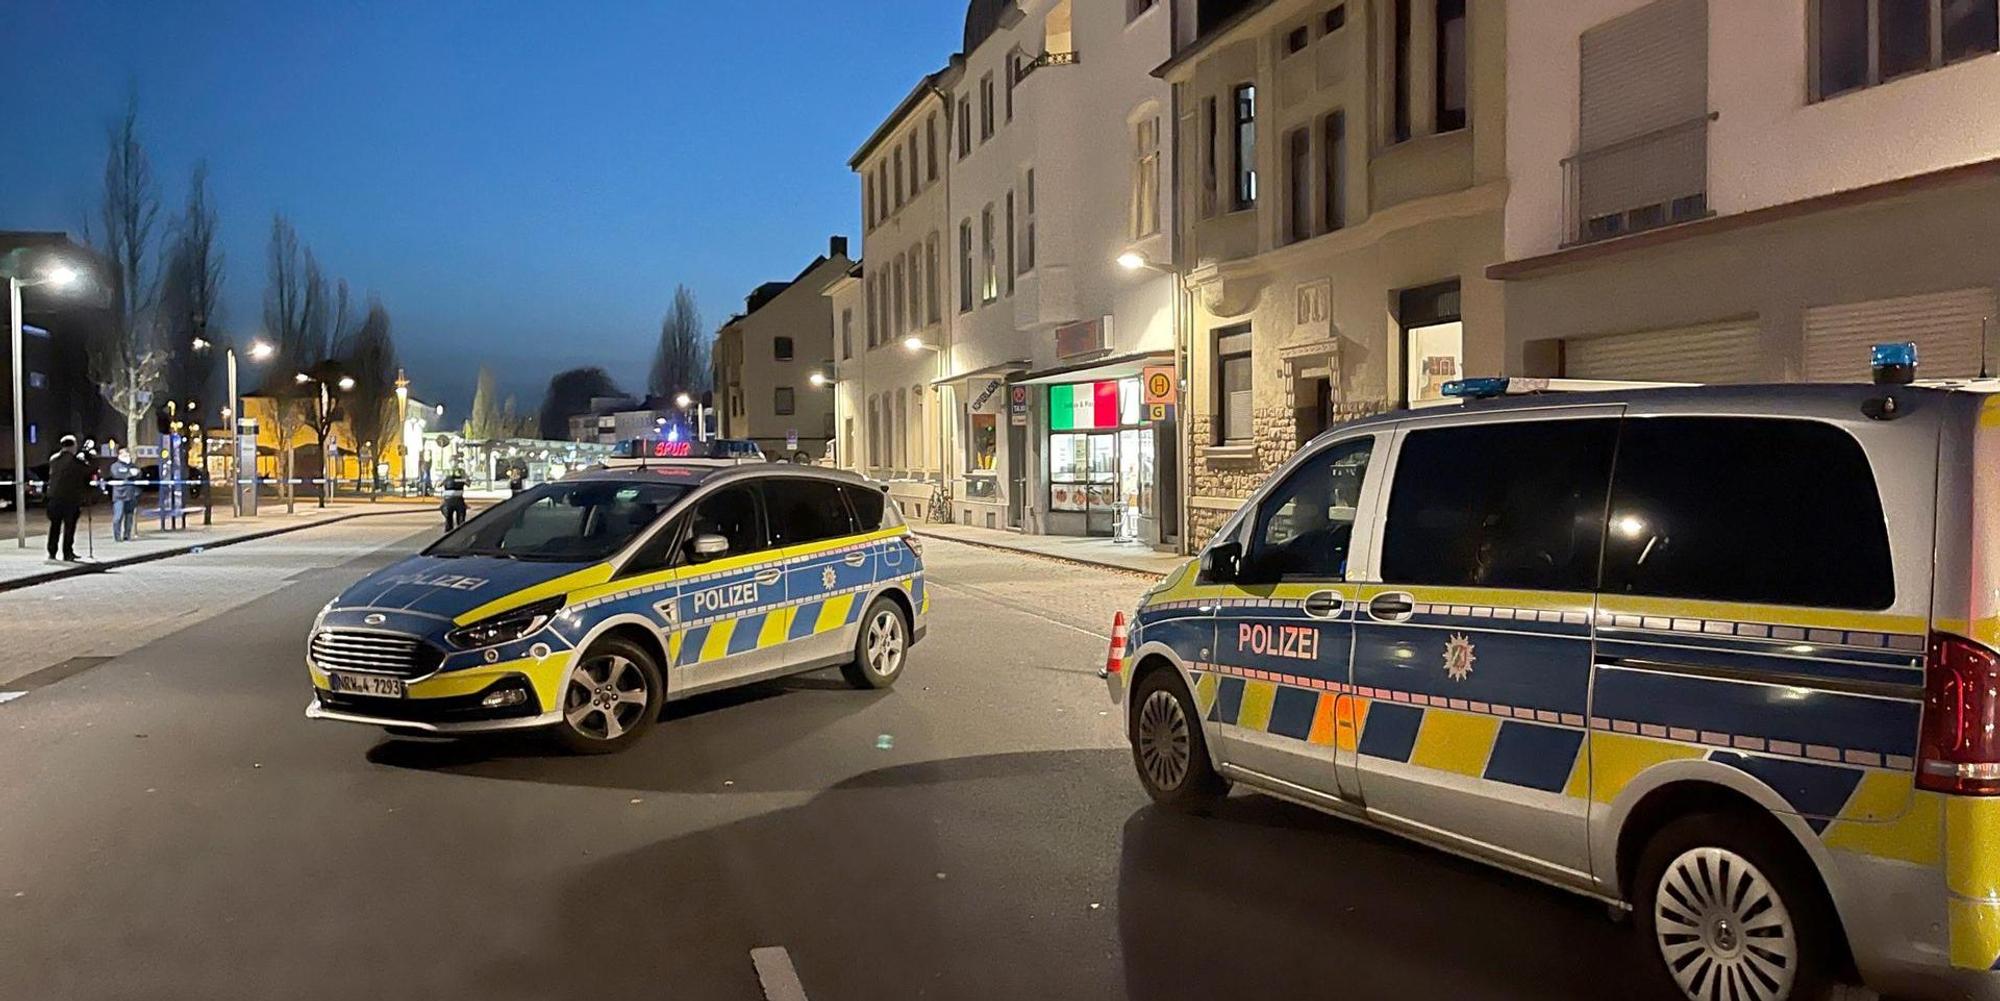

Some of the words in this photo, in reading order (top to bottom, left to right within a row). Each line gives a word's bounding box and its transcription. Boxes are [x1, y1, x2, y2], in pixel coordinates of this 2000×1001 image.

[1154, 378, 1165, 393] H
[1152, 406, 1163, 418] G
[655, 441, 690, 456] SPUR
[376, 574, 490, 591] POLIZEI
[694, 582, 759, 614] POLIZEI
[1238, 622, 1319, 660] POLIZEI
